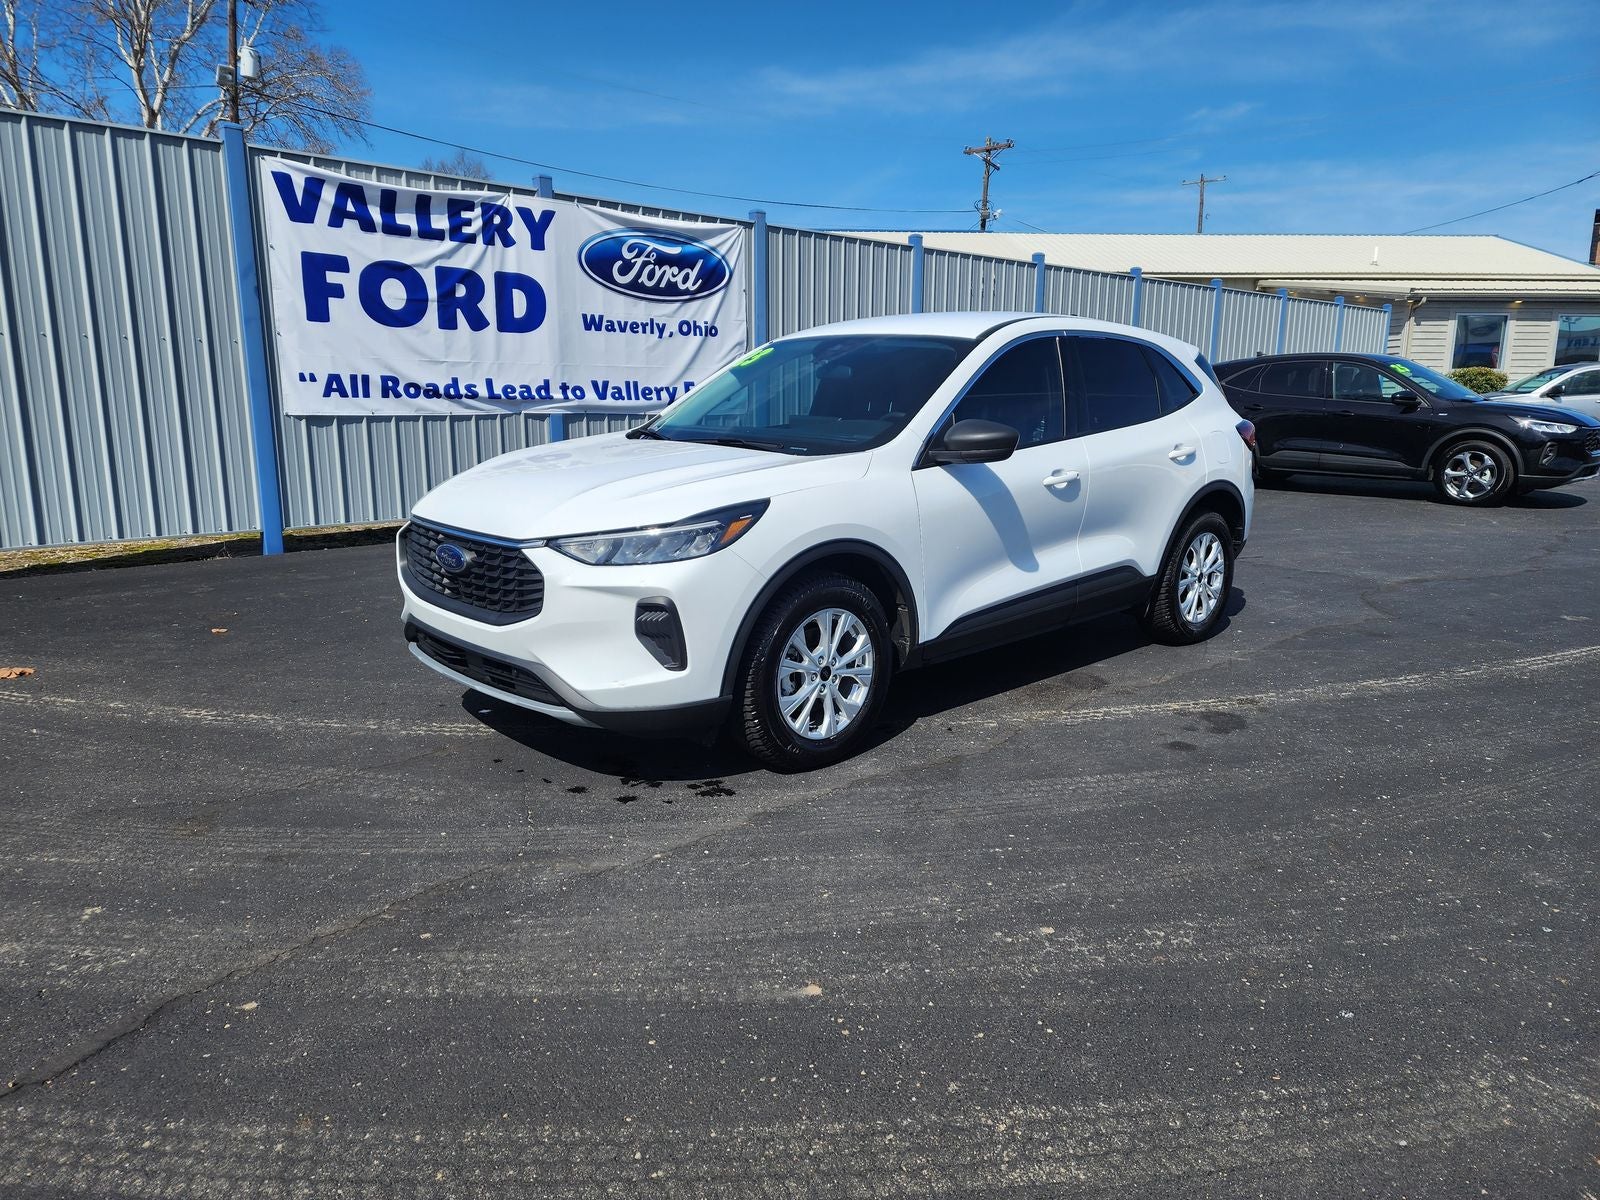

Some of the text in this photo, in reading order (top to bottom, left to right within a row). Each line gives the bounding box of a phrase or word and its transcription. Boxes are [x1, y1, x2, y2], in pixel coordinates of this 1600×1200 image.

[271, 170, 556, 250] VALLERY
[612, 238, 703, 291] Ford
[301, 251, 547, 333] FORD
[581, 313, 719, 339] Waverly, Ohio
[380, 374, 479, 399] Roads
[485, 378, 554, 400] Lead
[559, 381, 586, 400] to
[590, 379, 678, 406] Vallery
